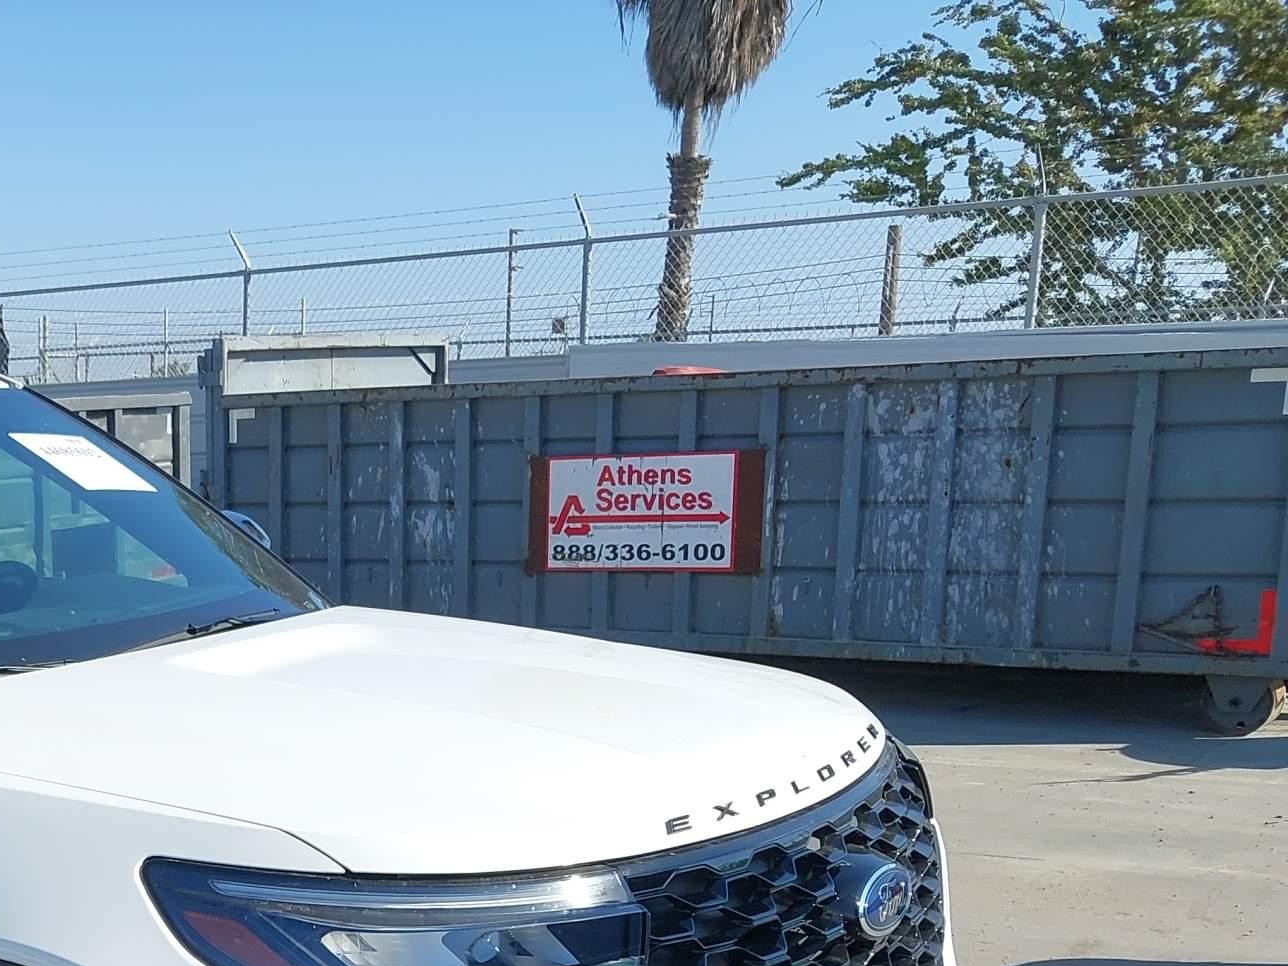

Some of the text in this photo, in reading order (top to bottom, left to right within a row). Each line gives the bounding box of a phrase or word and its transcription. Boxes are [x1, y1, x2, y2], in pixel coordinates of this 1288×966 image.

[596, 464, 692, 486] Athens
[595, 488, 713, 512] Services
[552, 543, 726, 562] 888/336-6100
[665, 723, 879, 835] EXPLORER
